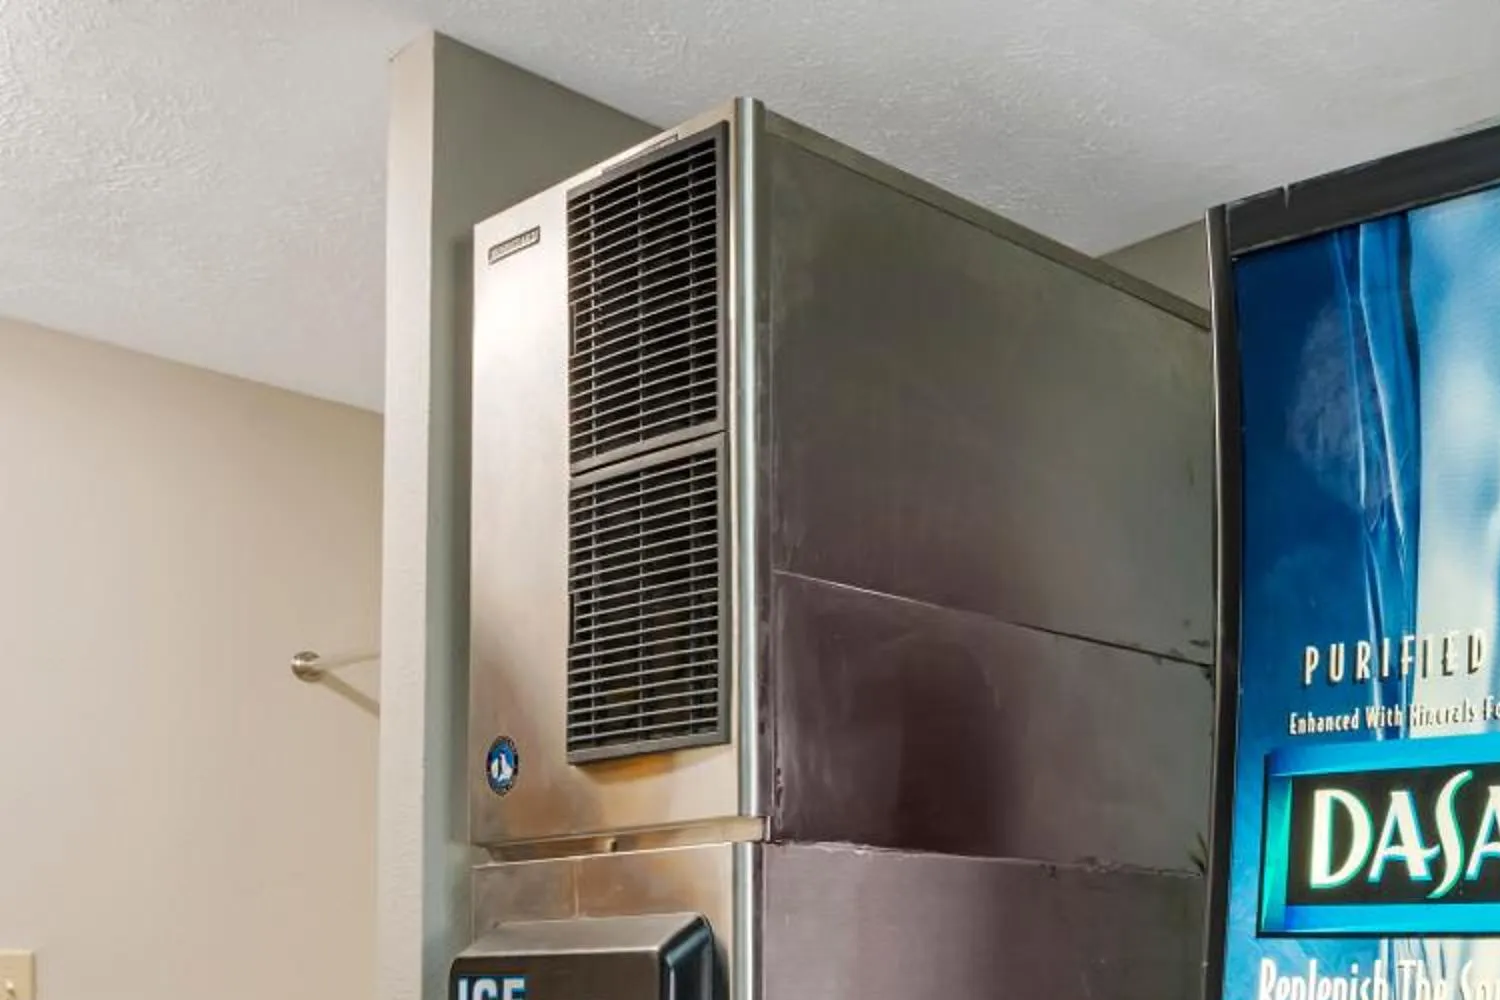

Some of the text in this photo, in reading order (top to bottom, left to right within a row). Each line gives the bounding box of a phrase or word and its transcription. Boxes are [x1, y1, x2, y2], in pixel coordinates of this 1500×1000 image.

[1303, 630, 1487, 687] PURIFIED
[1289, 712, 1360, 735] Enhanced
[1365, 704, 1401, 729] With
